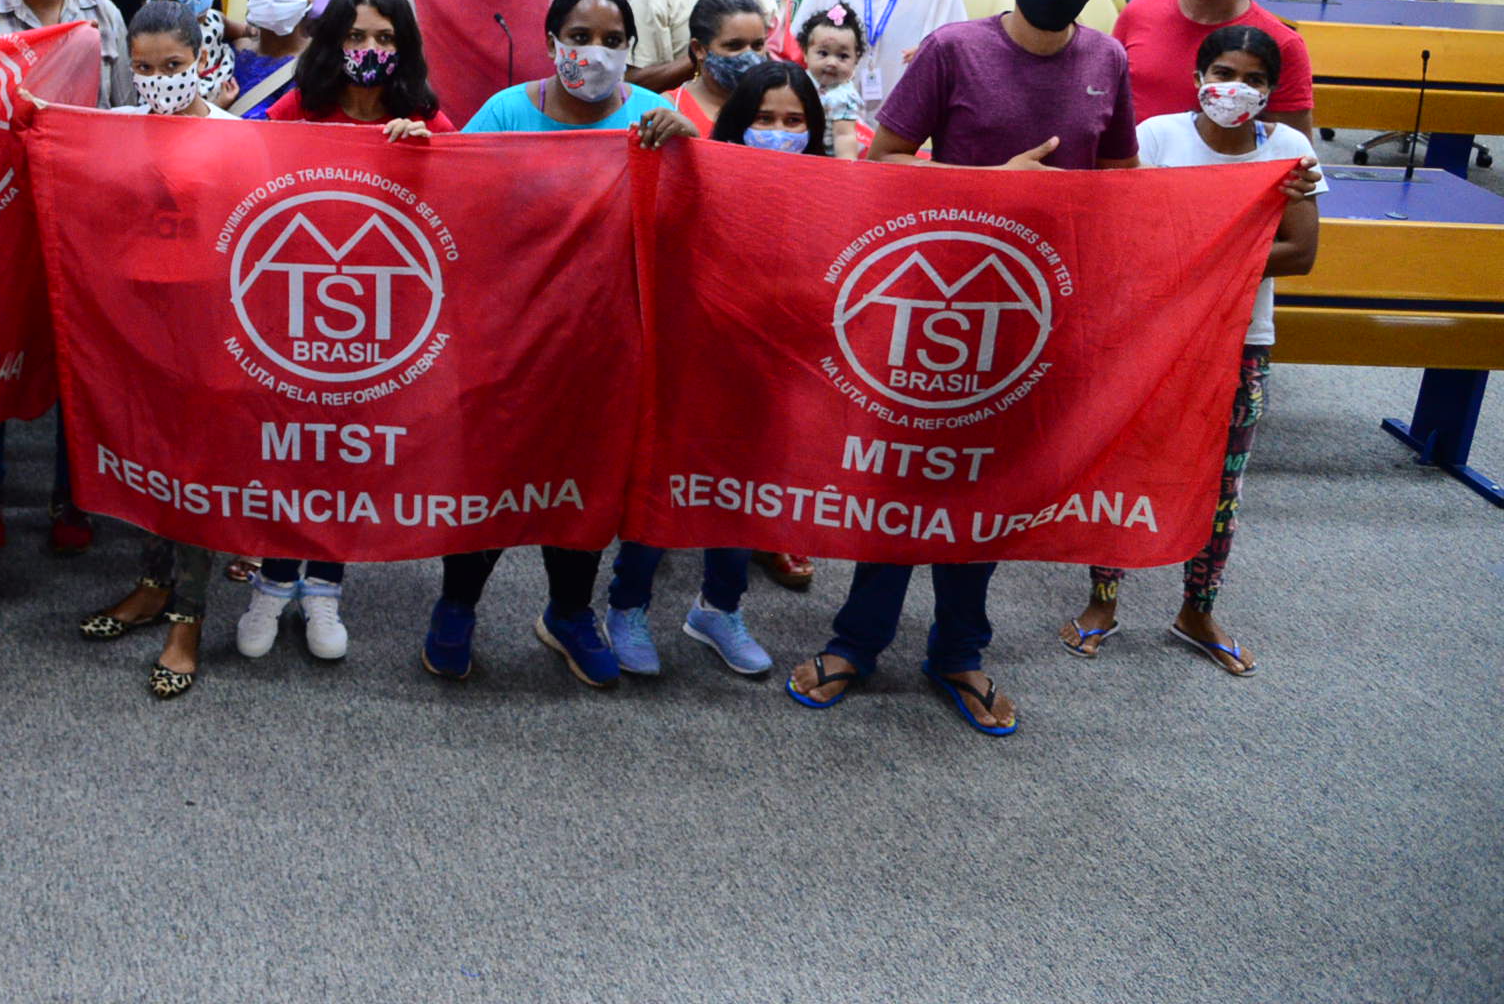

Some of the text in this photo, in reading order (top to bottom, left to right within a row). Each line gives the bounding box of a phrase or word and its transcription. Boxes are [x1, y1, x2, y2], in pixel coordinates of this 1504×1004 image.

[215, 186, 268, 254] MOVIMENTO
[266, 173, 296, 194] DOS
[297, 167, 416, 205] TRABALHADORES
[415, 201, 442, 229] SEM
[436, 223, 459, 261] TETO
[824, 208, 1074, 297] MOVIMENTO DOS TRABALHADORES SEM TETO
[224, 330, 451, 406] NA LUTA PELA REFORMA URBANA
[293, 340, 387, 363] BRASIL
[889, 368, 987, 393] BRASIL
[820, 355, 1053, 430] NA LUTA PELA REFORMA URBANA
[261, 422, 407, 466] MTST
[841, 435, 994, 482] MTST
[97, 443, 586, 527] RESISTÊNCIA URBANA
[669, 474, 956, 543] RESISTÊNCIA
[971, 490, 1159, 543] URBANA
